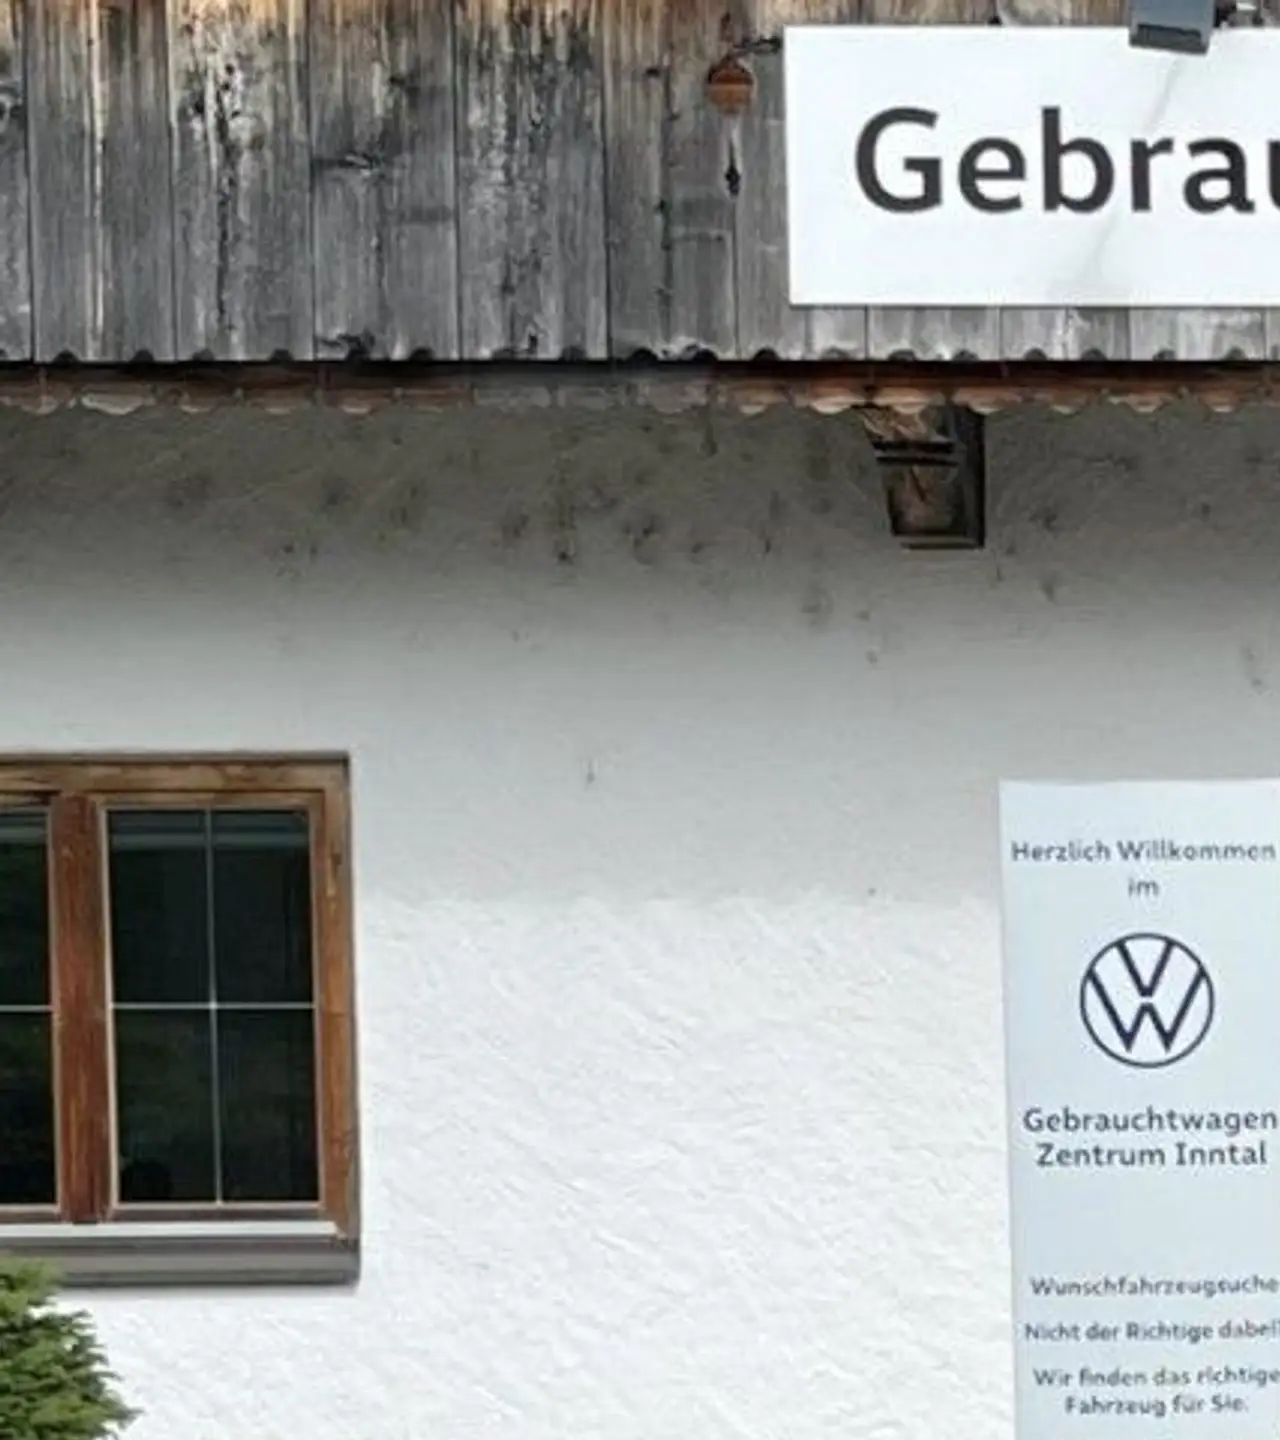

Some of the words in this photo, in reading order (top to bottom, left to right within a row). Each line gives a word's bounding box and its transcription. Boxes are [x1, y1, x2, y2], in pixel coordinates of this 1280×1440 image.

[1011, 840, 1110, 862] Herzlich
[1116, 840, 1277, 862] Willkommen
[1127, 878, 1160, 897] im
[1081, 932, 1215, 1068] VW
[1023, 1106, 1278, 1135] Gebrauchtwagen
[1036, 1142, 1166, 1168] Zentrum
[1175, 1139, 1267, 1167] Inntal
[1030, 1274, 1280, 1299] Wunschfahrzeugsuche
[1024, 1320, 1080, 1341] Nicht
[1085, 1319, 1120, 1341] der
[1125, 1319, 1214, 1345] Richtige
[1032, 1367, 1073, 1387] Wir
[1078, 1367, 1148, 1387] finden
[1152, 1367, 1193, 1387] das
[1064, 1395, 1167, 1418] Fahrzeug
